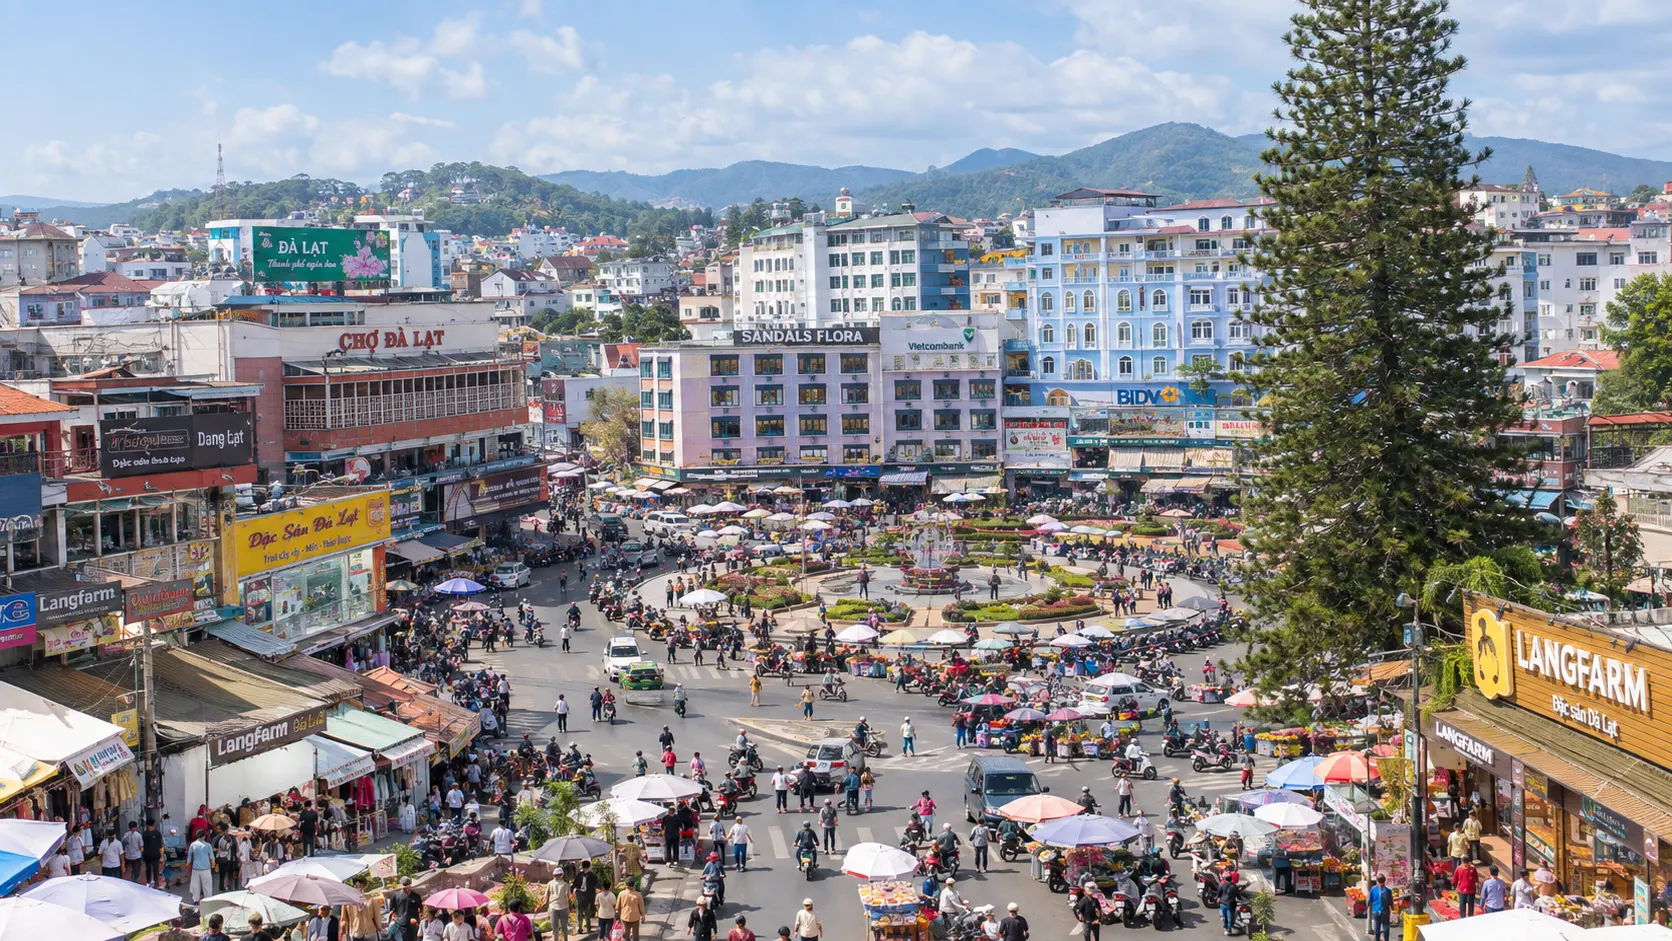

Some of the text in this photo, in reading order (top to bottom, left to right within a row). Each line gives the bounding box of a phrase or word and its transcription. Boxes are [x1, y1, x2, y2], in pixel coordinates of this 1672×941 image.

[278, 238, 328, 257] ĐÀ LẠT
[339, 326, 445, 353] CHỢ ĐÀ LẠT
[742, 330, 863, 343] SANDALS FLORA
[908, 341, 965, 351] Vietcombank
[1117, 389, 1161, 405] BIDV
[40, 588, 116, 612] Langfarm
[1516, 629, 1649, 712] LANGFARM
[1435, 721, 1493, 765] LANGFARM
